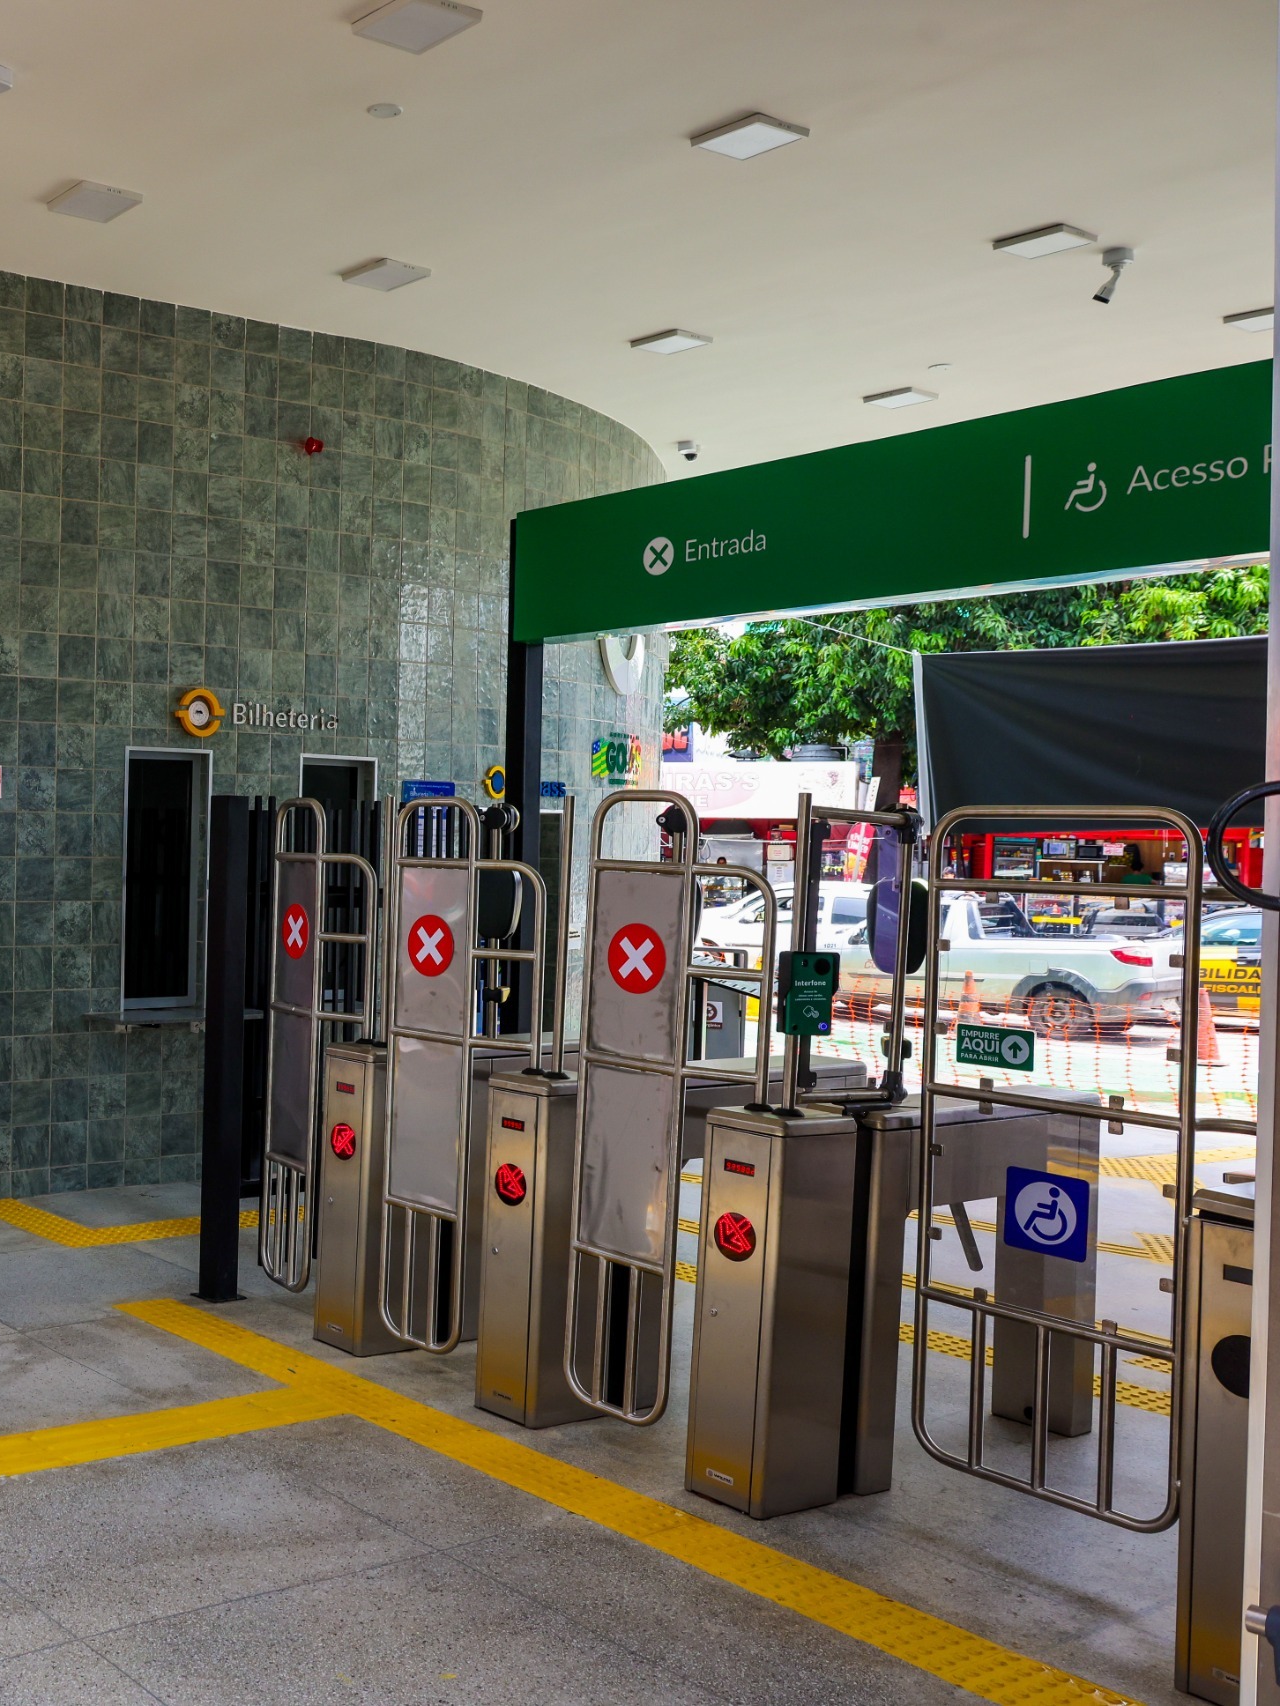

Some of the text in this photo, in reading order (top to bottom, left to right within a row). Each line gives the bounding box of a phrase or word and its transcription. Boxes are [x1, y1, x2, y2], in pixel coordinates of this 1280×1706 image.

[1126, 456, 1249, 495] Acesso
[685, 529, 767, 562] Entrada
[232, 701, 338, 731] Bilheteria
[540, 781, 567, 798] ass
[1199, 968, 1261, 980] BILIDA
[1203, 984, 1261, 994] FISCALI
[961, 1029, 1000, 1040] EMPURRE
[961, 1037, 1000, 1053] AQUI
[960, 1052, 999, 1063] PARA ABRIR
